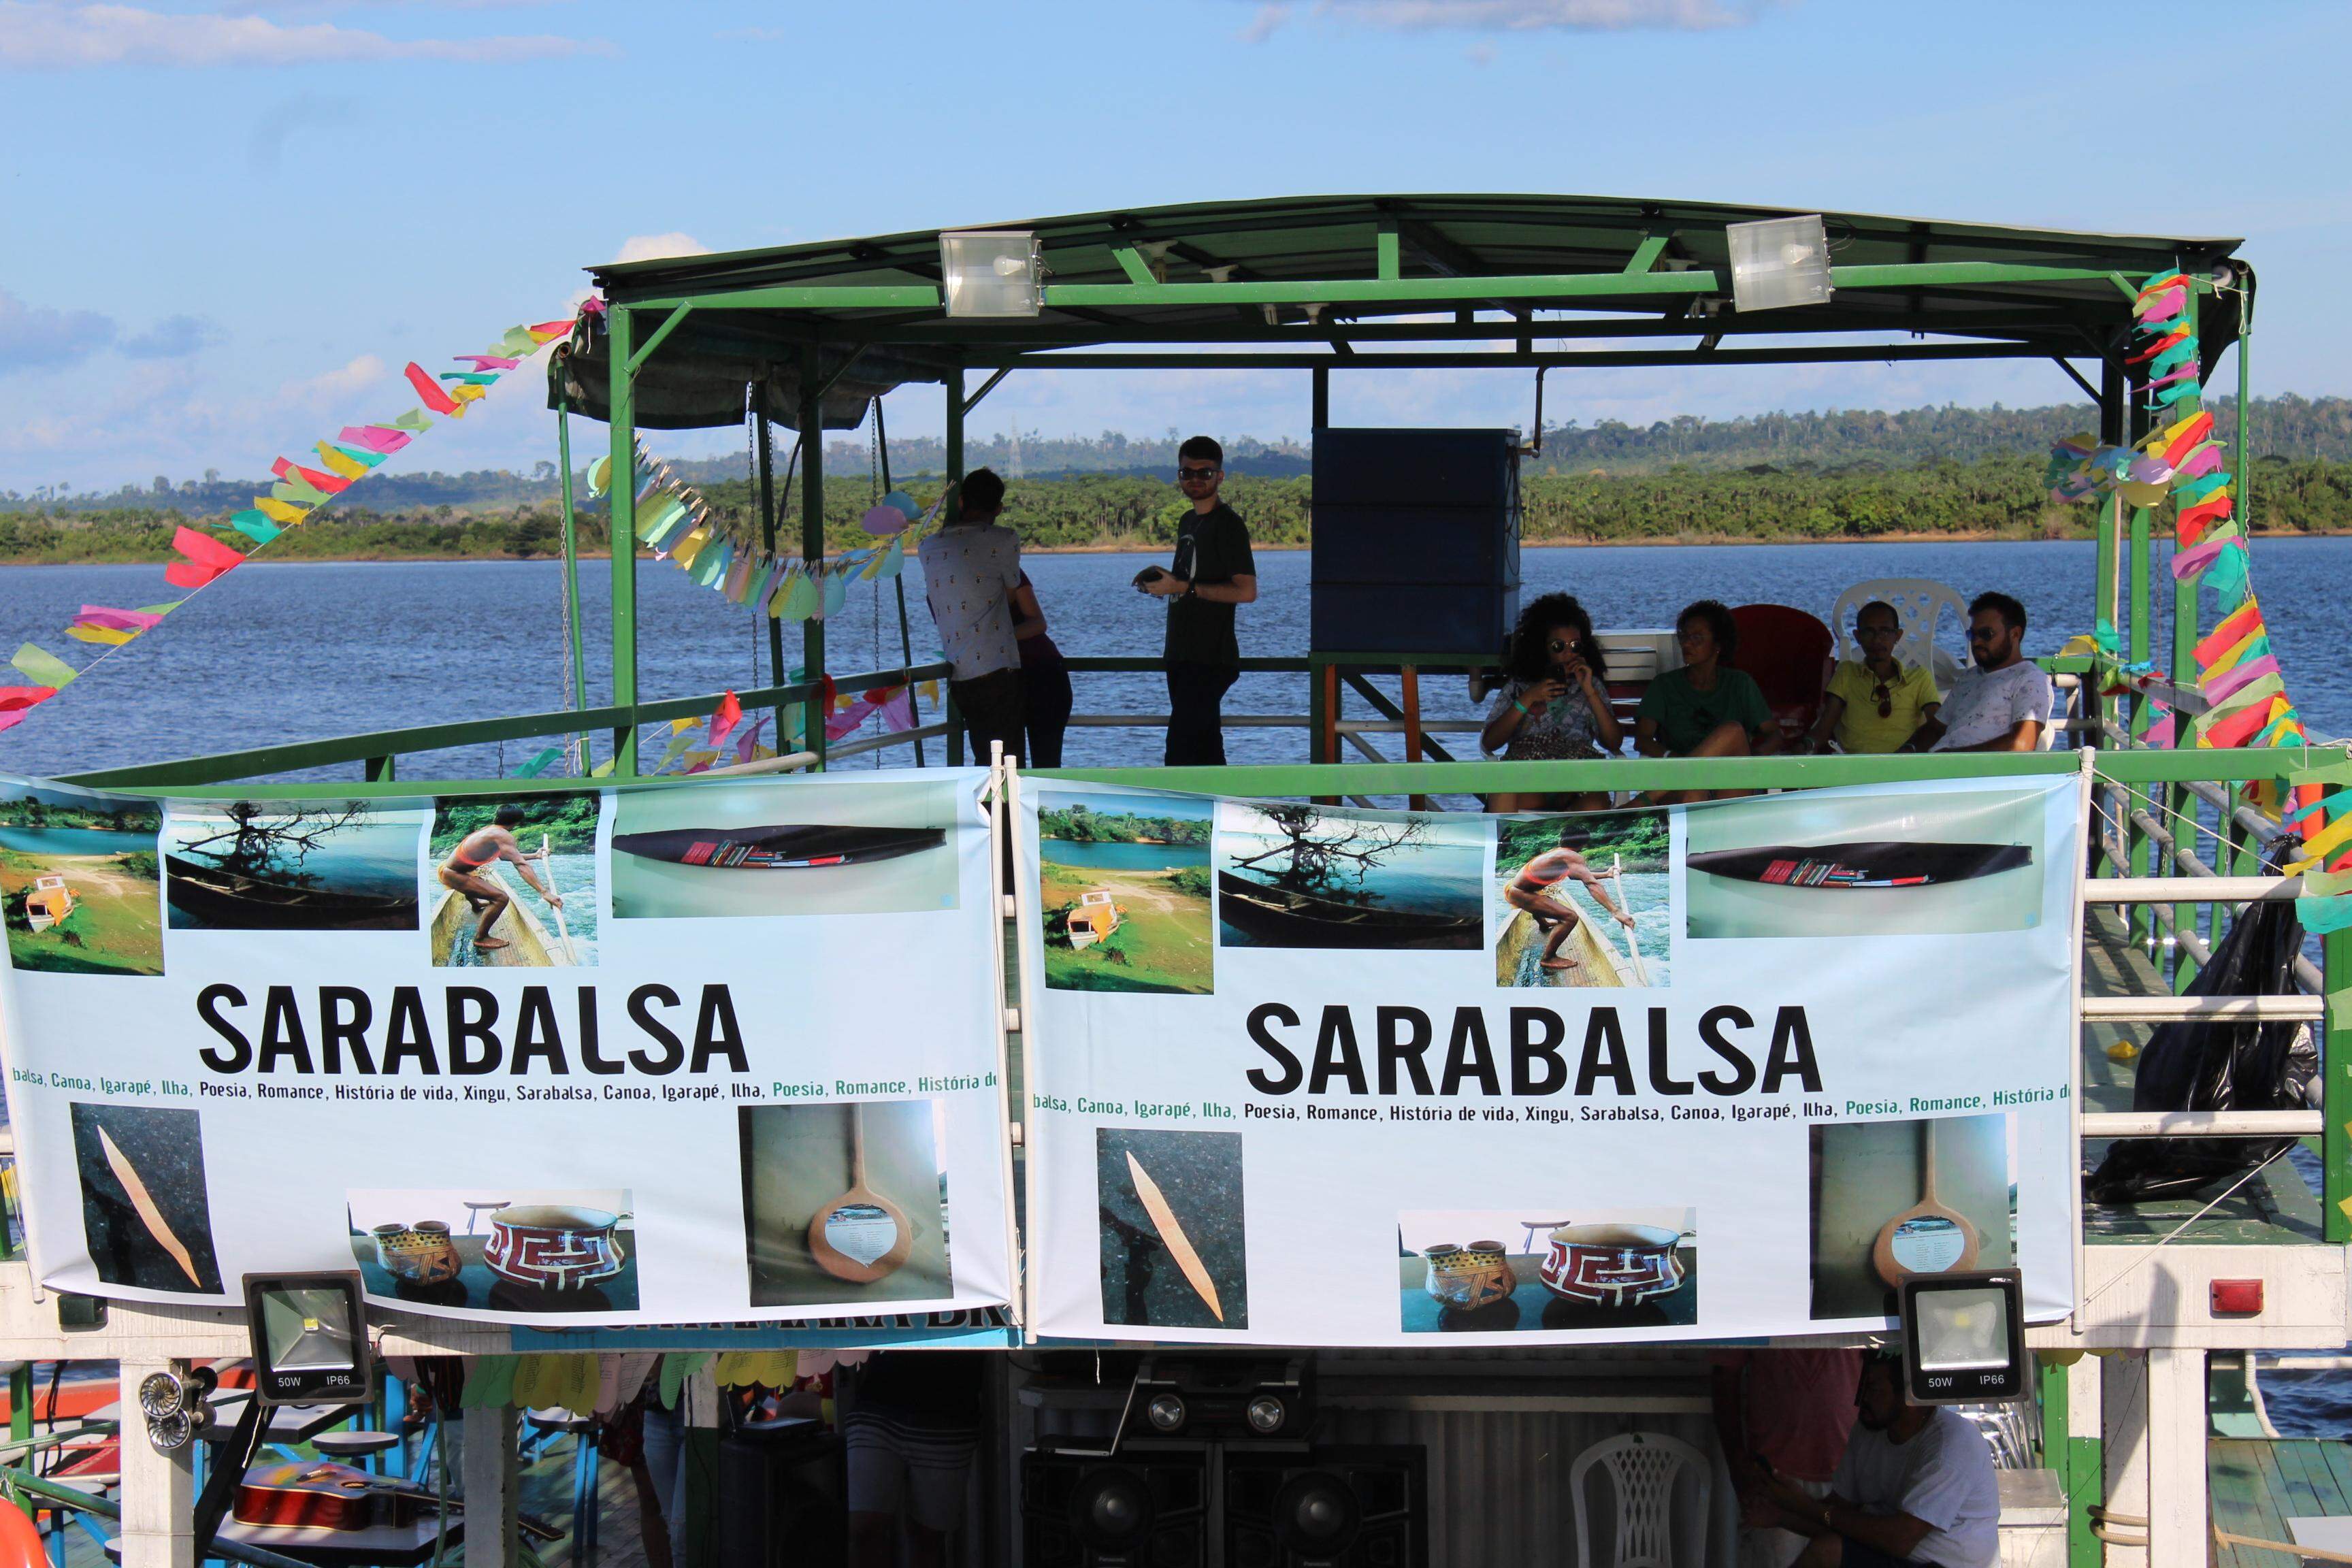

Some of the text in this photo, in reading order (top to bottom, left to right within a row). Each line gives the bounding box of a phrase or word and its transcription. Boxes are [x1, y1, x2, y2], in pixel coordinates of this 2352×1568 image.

[197, 984, 750, 1076] SARABALSA
[1246, 1002, 1823, 1096] SARABALSA
[13, 1068, 47, 1088] balsa,
[52, 1073, 95, 1092] Canoa,
[101, 1077, 156, 1096] Igarapé,
[162, 1080, 193, 1097] Ilha,
[200, 1081, 252, 1100] Poesia,
[258, 1083, 329, 1101] Romance,
[336, 1083, 394, 1100] História
[401, 1085, 417, 1100] de
[423, 1085, 459, 1102] vida,
[464, 1085, 510, 1103] Xingu,
[517, 1085, 598, 1102] Sarabalsa,
[604, 1084, 656, 1100] Canoa,
[662, 1083, 725, 1102] Igarapé,
[732, 1083, 766, 1099] Ilha,
[773, 1081, 829, 1097] Poesia,
[836, 1079, 911, 1095] Romance,
[919, 1074, 979, 1092] História
[1033, 1083, 2070, 1124] balsa, Canoa, Igarapé, Ilha, Poesia, Romance, História de vida, Xingu, Sarabalsa, Canoa, Igarapé, Ilha, Poesia, Romance, História d
[278, 1375, 350, 1387] 50W IP66
[1928, 1375, 2004, 1387] 50W IP66
